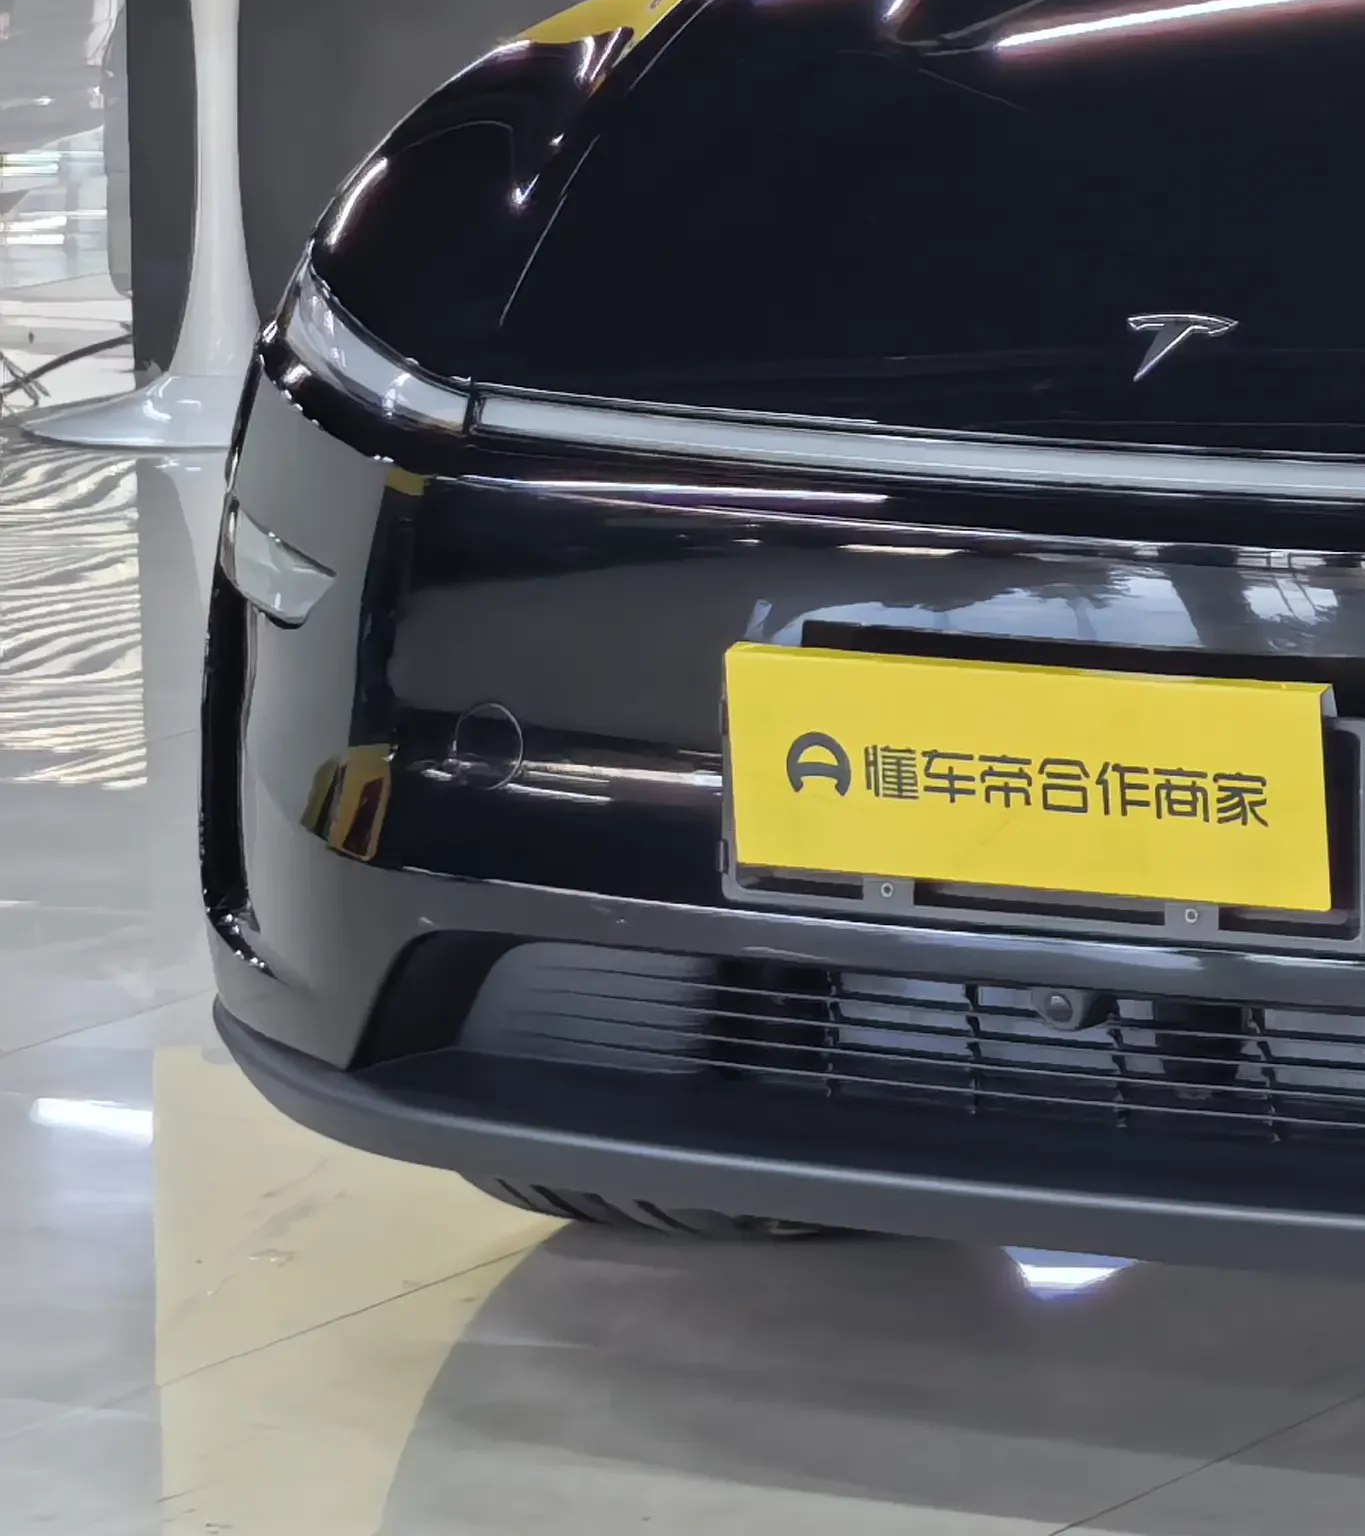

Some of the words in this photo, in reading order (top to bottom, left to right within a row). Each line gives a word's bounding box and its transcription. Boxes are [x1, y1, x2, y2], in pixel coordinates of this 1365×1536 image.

[864, 744, 1270, 828] 懂车帝合作商家
